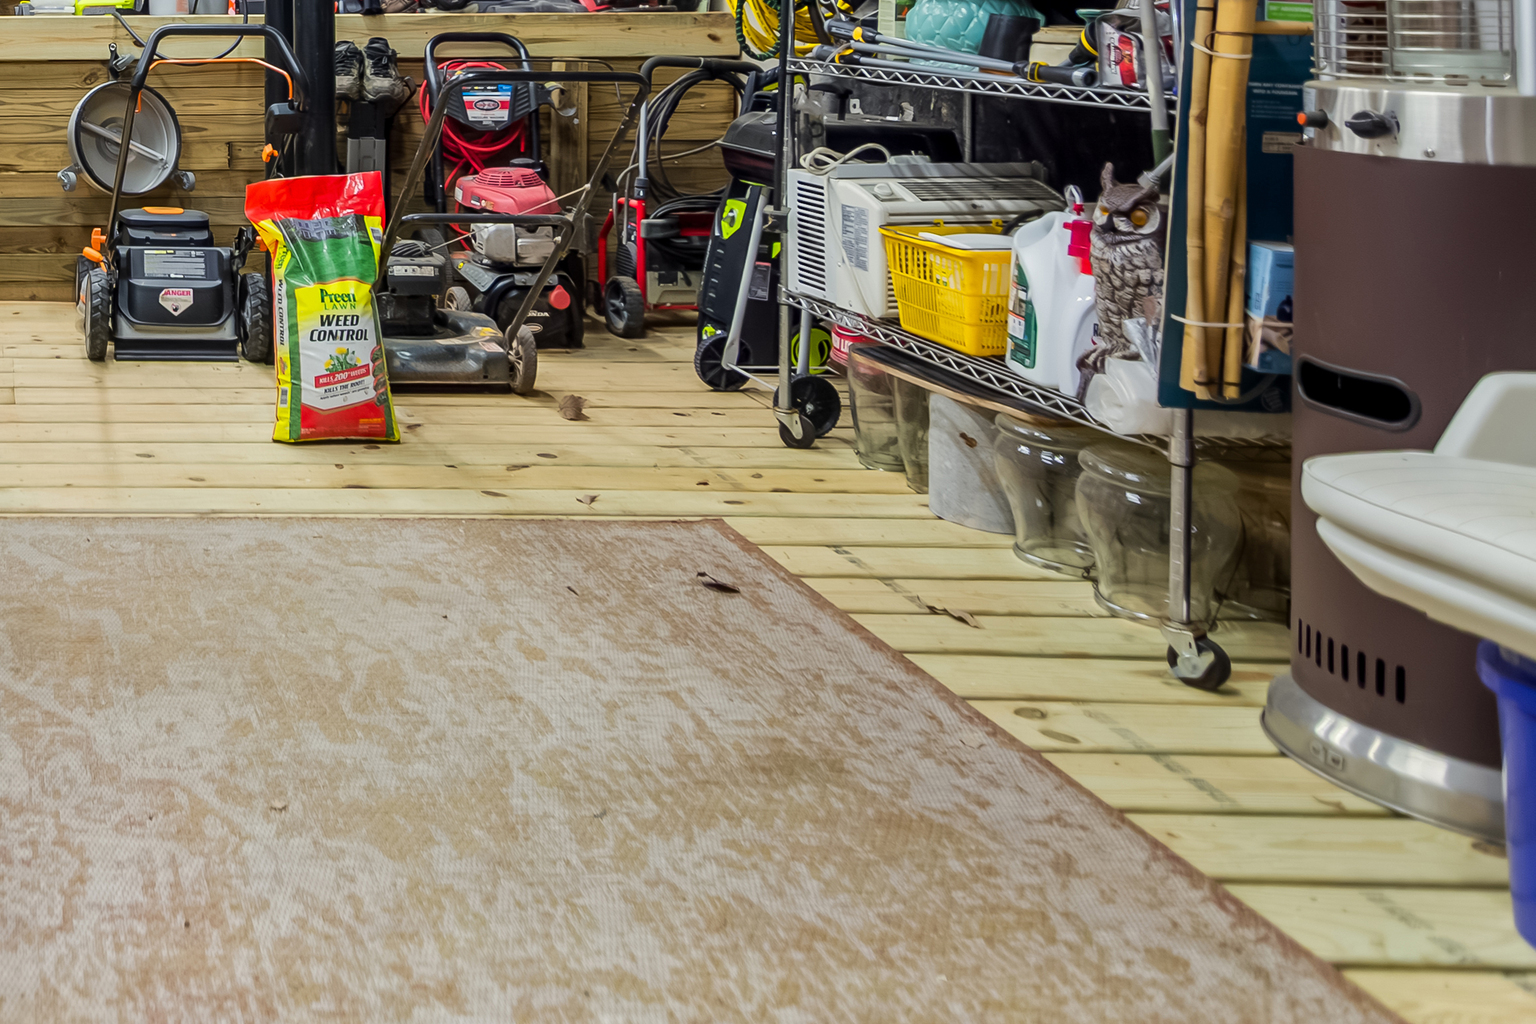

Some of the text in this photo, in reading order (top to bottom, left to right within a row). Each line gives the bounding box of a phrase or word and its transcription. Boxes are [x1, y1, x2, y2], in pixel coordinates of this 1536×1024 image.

[319, 288, 357, 304] Preen
[320, 314, 360, 327] WEED
[309, 329, 369, 342] CONTROL
[319, 377, 334, 385] KILLS
[324, 386, 339, 394] KILLS
